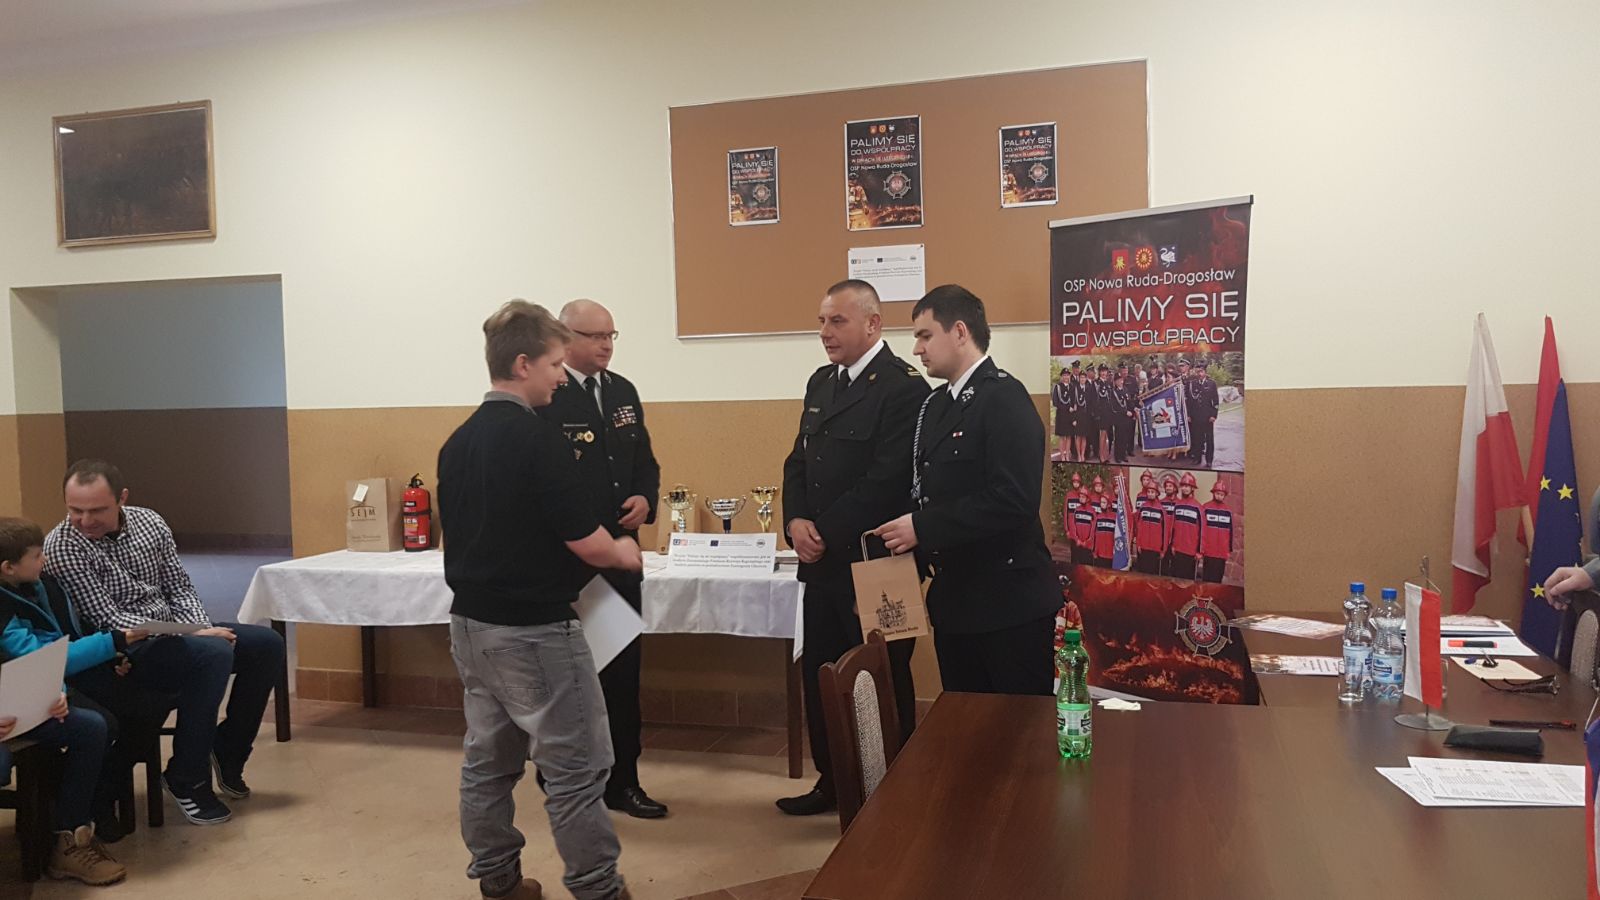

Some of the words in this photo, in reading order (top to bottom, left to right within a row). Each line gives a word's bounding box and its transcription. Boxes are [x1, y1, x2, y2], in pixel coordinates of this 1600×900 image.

[850, 136, 893, 148] PALIMY
[897, 134, 916, 144] SIĘ
[1004, 138, 1036, 147] PALIMY
[1063, 279, 1085, 293] OSP
[1089, 277, 1123, 291] Nowa
[1126, 267, 1236, 288] Ruda-Drogosław
[1062, 295, 1174, 325] PALIMY
[1185, 291, 1239, 321] SIĘ
[1062, 332, 1088, 349] DO
[1093, 322, 1240, 347] WSPÓŁPRACY
